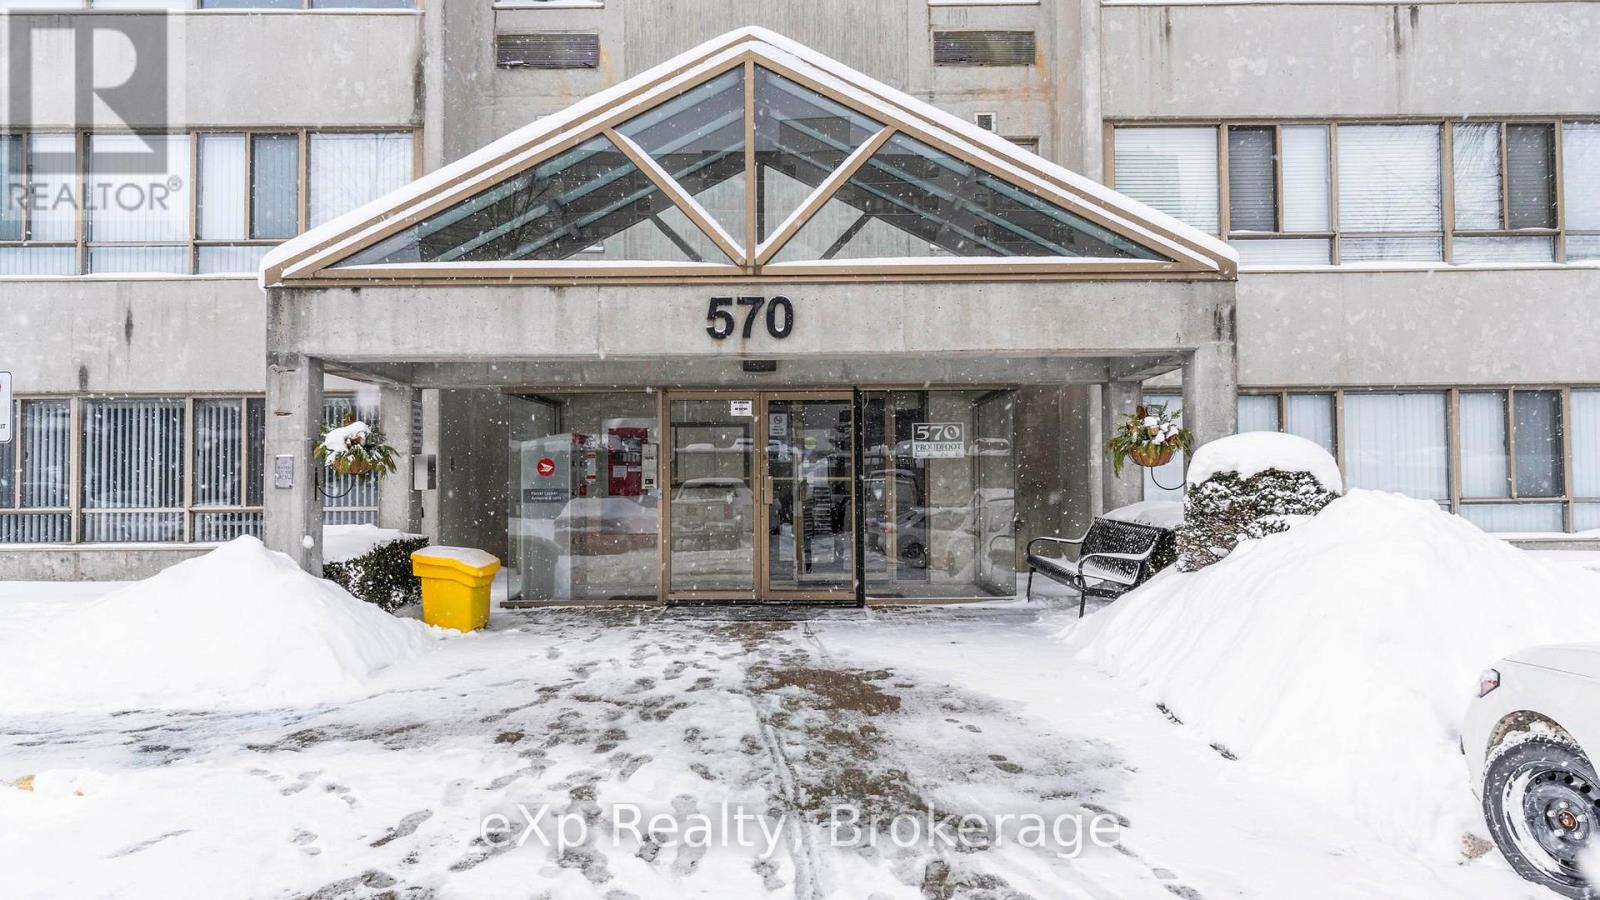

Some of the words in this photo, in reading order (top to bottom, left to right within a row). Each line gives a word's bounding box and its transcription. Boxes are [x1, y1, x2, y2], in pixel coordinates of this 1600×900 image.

[706, 295, 794, 340] 570
[915, 425, 960, 441] 570
[915, 443, 962, 451] PROUDFOOT
